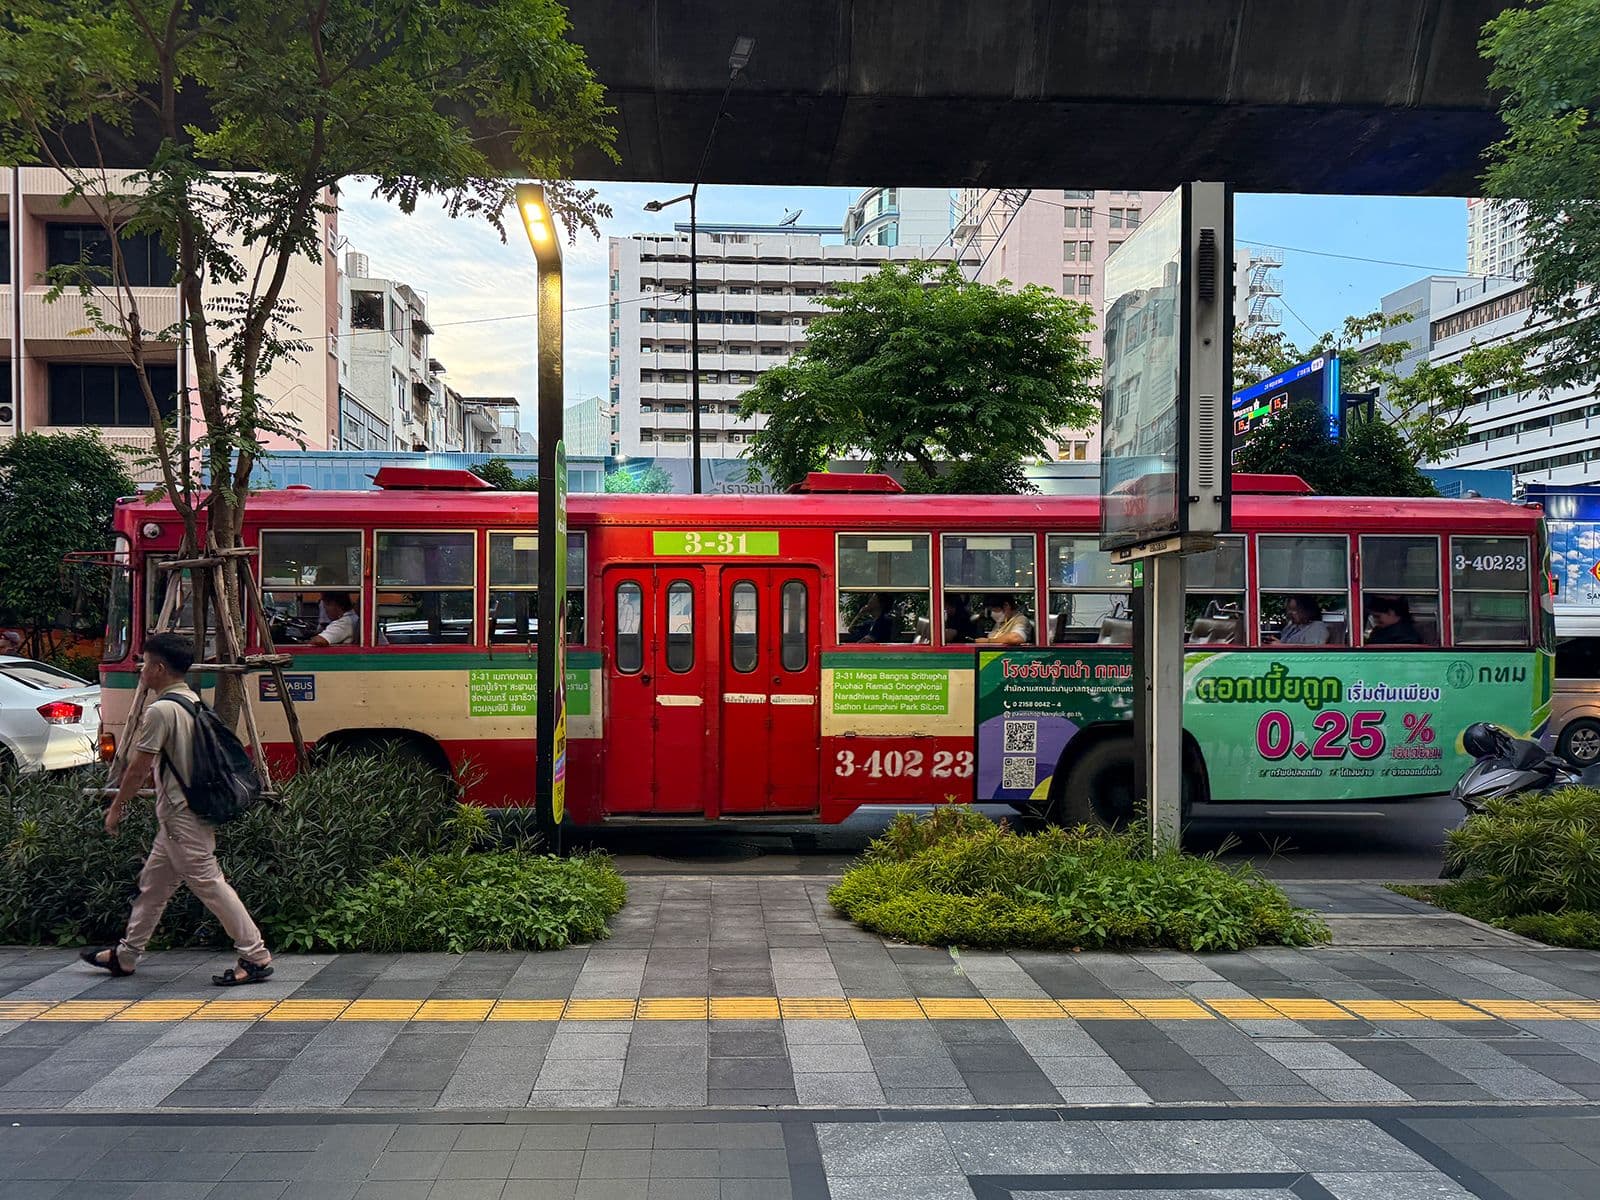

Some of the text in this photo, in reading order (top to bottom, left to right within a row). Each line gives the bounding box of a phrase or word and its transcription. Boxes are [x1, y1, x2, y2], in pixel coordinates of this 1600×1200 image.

[685, 531, 748, 554] 3-31
[1455, 555, 1526, 571] 3-40223
[835, 672, 853, 680] 3-31
[856, 672, 878, 681] Mega
[879, 672, 909, 681] Bangna
[1001, 659, 1090, 679] โรงรับจำนำ
[1478, 667, 1526, 683] กทม
[834, 682, 864, 690] Puchao
[866, 682, 893, 690] Rama3
[1197, 663, 1441, 709] ดอกเบี้ยถูก เริ่มต้นเพียง
[834, 692, 880, 700] Naradhiwas
[834, 703, 861, 711] Sathon
[900, 703, 918, 711] Park
[1256, 711, 1436, 760] 0.25 %
